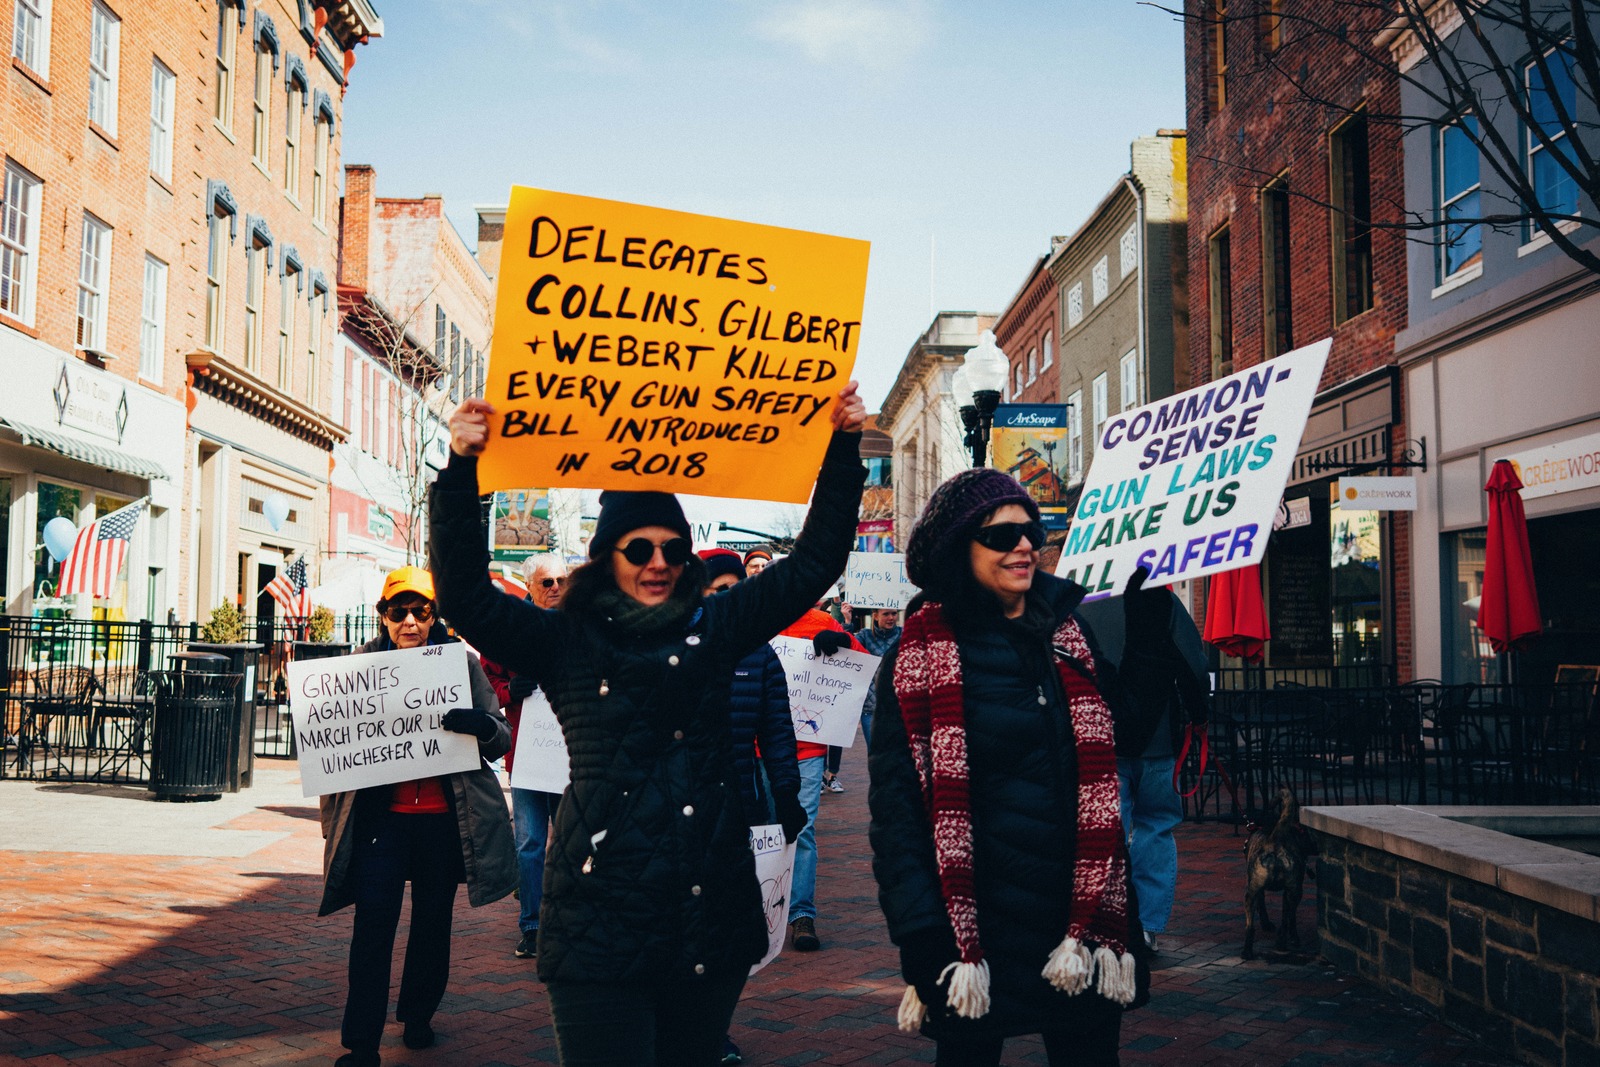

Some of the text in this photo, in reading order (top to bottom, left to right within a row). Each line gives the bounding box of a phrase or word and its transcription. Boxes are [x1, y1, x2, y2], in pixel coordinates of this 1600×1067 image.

[528, 216, 768, 285] DELEGATES
[719, 300, 861, 353] GILBERT
[723, 345, 837, 383] KILLED
[507, 371, 832, 427] EVERY GUN SAFETY
[1102, 364, 1292, 451] COMMON-
[501, 409, 780, 447] BILL INTRODUCED
[1007, 413, 1056, 426] ArtScape
[1138, 402, 1265, 471] SENSE
[556, 448, 708, 479] IN 2018
[1077, 434, 1278, 521] GUN LAWS
[1063, 480, 1240, 557] MAKE US
[847, 553, 882, 586] Prayers
[885, 571, 892, 582] &
[1136, 523, 1260, 581] SAFER
[868, 594, 885, 607] Save
[422, 646, 443, 656] 2018
[772, 640, 864, 672] ote for Leaders
[788, 688, 838, 706] un laws!
[792, 670, 853, 695] will change
[307, 684, 462, 725] AGAINST GUNS
[299, 724, 351, 752] MARCH
[357, 720, 387, 741] FOR
[391, 713, 422, 737] OUR
[533, 720, 557, 730] GUN
[321, 739, 441, 775] WINCHESTER VA
